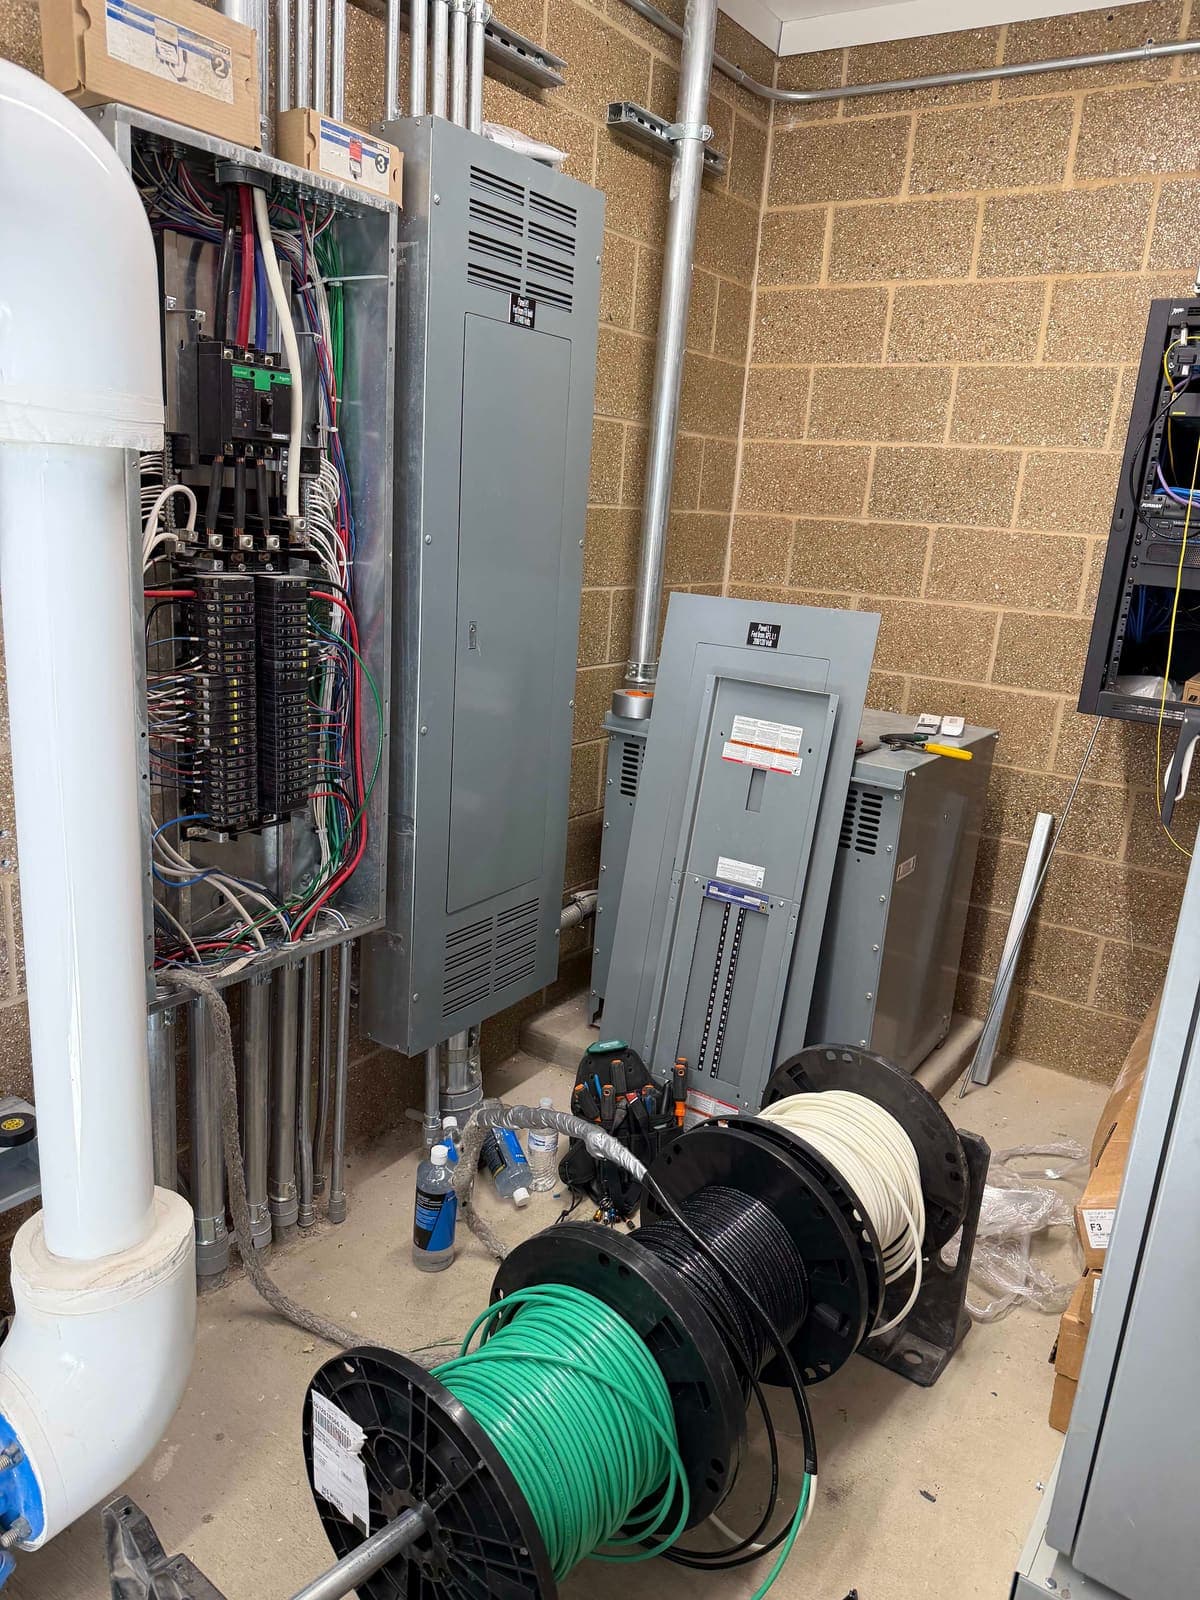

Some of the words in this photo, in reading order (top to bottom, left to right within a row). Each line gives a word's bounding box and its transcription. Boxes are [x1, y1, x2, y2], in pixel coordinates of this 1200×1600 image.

[214, 57, 227, 77] 2
[377, 155, 386, 174] 3
[1090, 1223, 1103, 1232] F3
